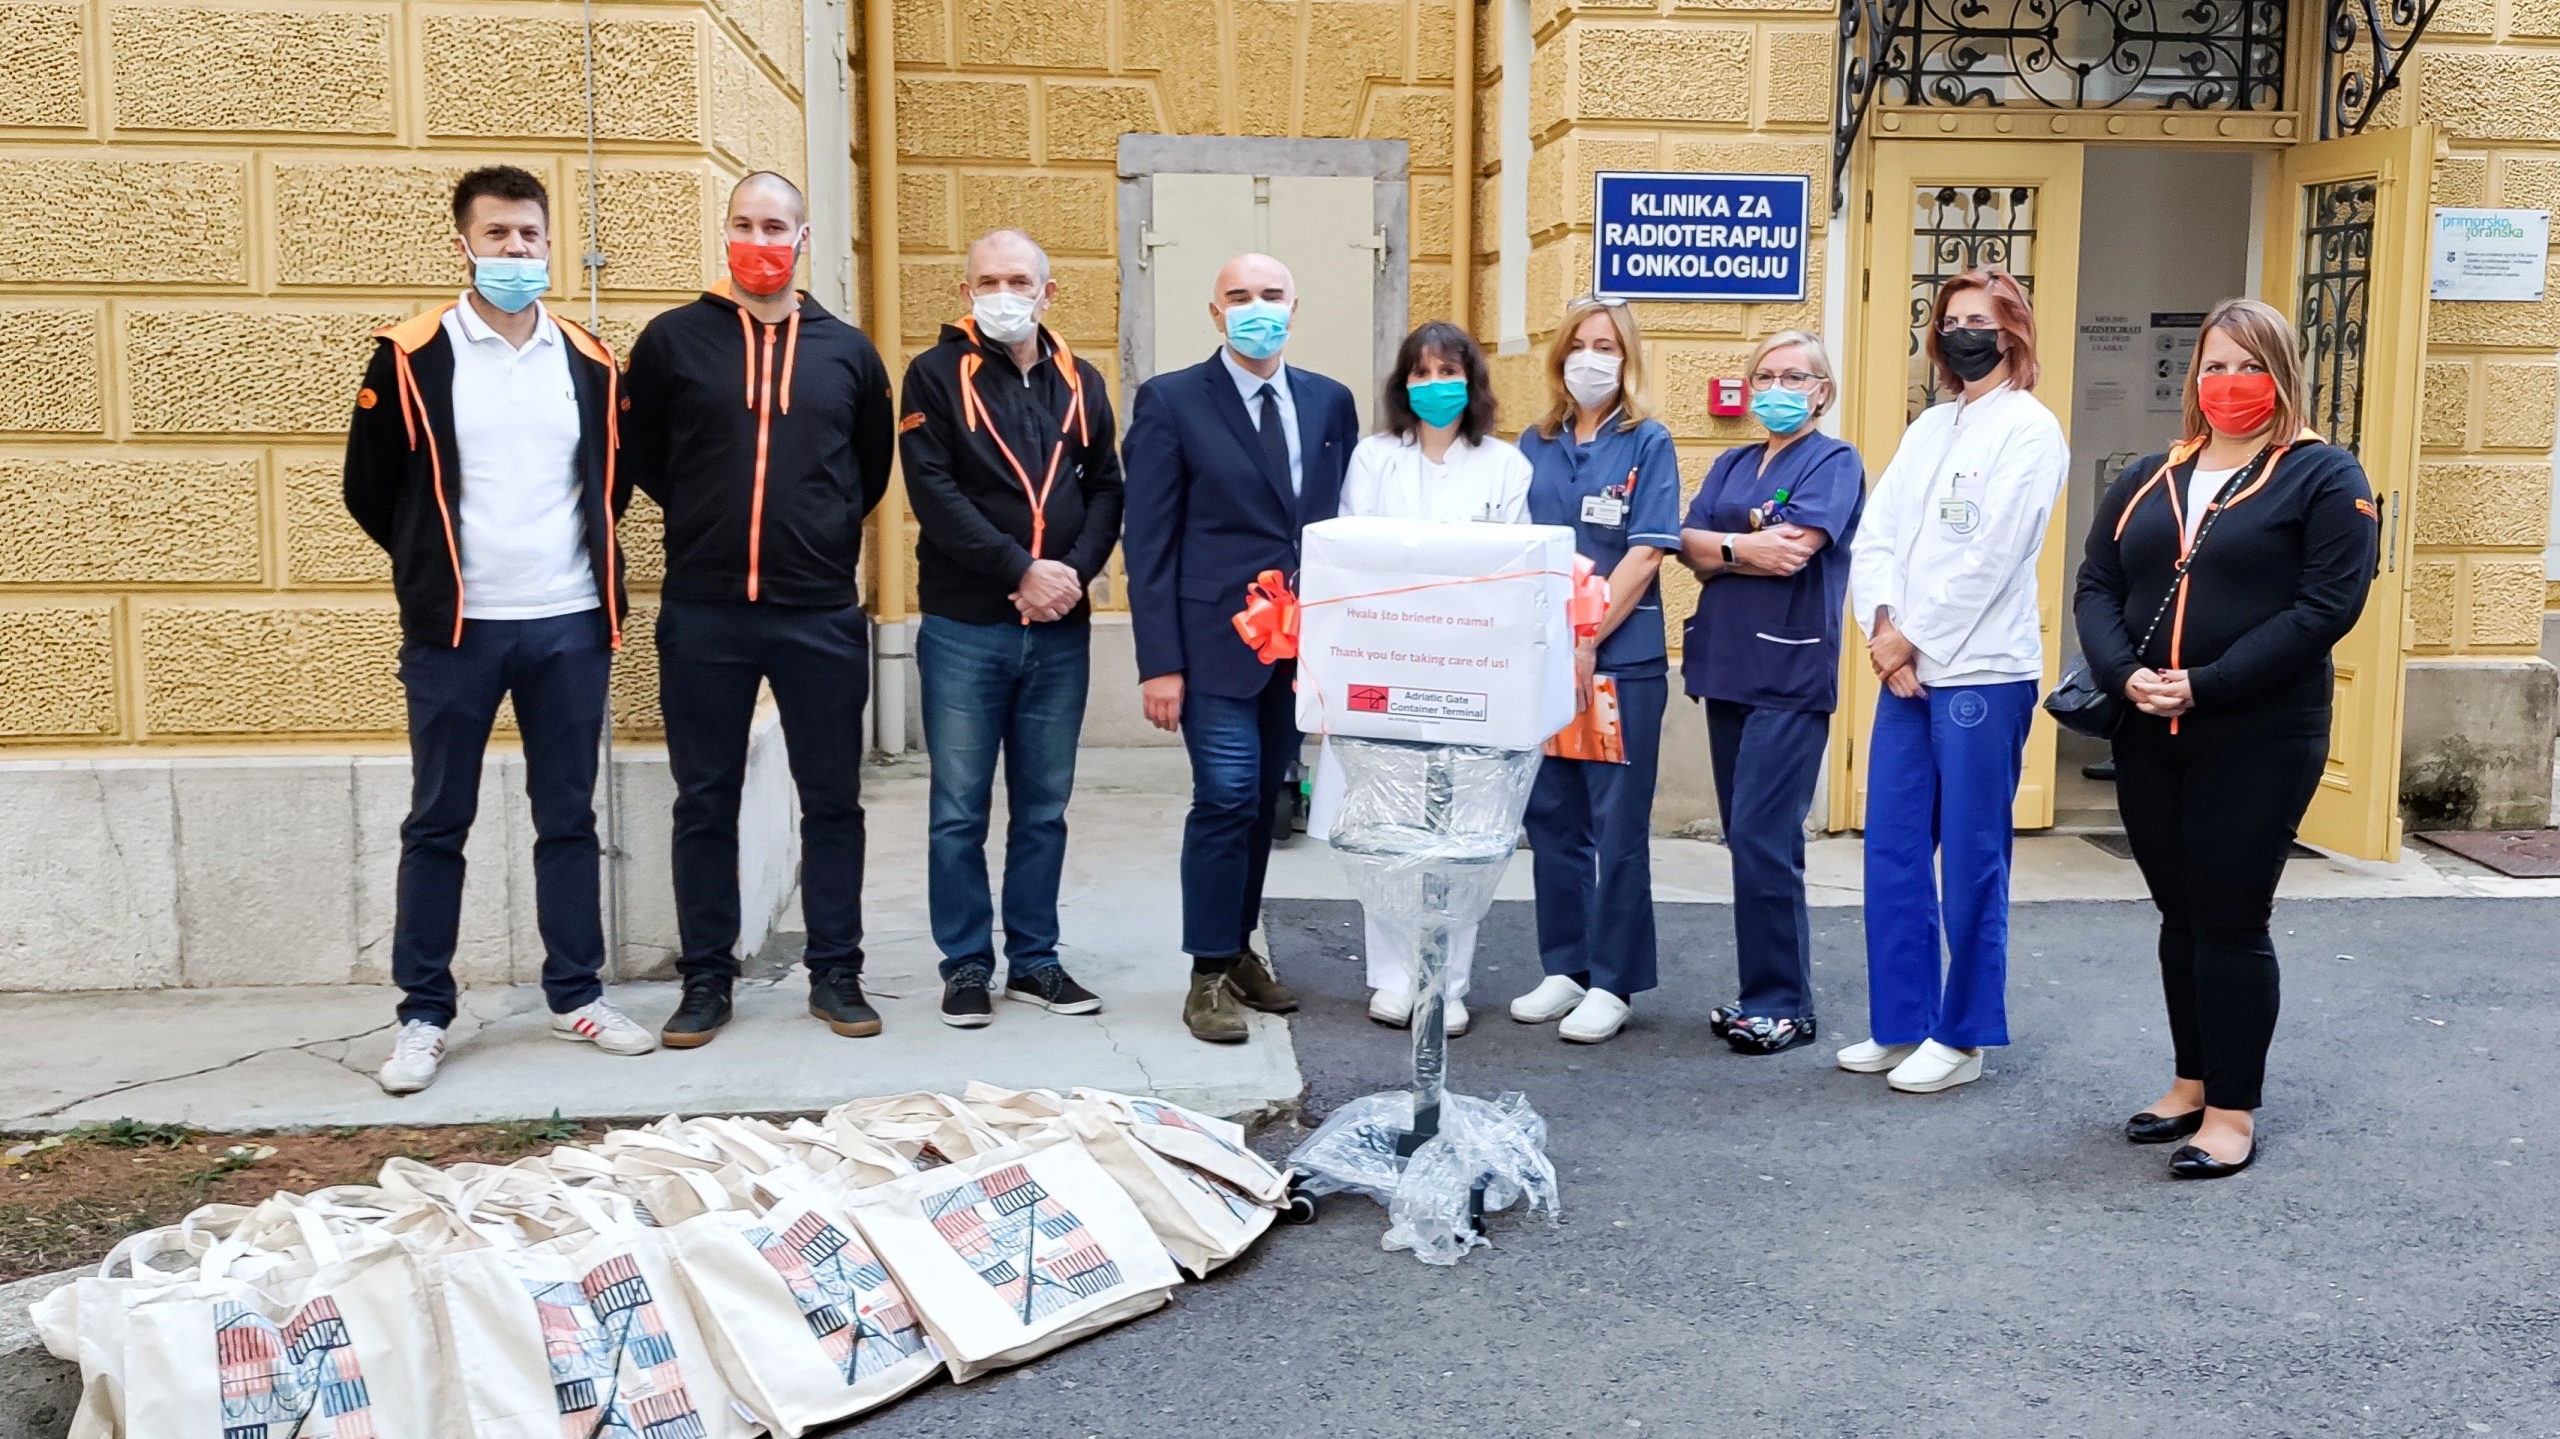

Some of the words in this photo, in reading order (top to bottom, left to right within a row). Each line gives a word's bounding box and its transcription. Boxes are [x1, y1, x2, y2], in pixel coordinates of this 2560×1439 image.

[1630, 194, 1730, 217] KLINIKA
[1738, 196, 1772, 218] ZA
[2442, 213, 2509, 230] primorsko
[1605, 224, 1797, 249] RADIOTERAPIJU
[2465, 224, 2524, 241] goranska
[1611, 254, 1620, 276] I
[1626, 254, 1789, 278] ONKOLOGIJU
[1347, 607, 1378, 620] Hvala
[1381, 609, 1399, 621] što
[1402, 611, 1443, 624] brinete
[1446, 616, 1454, 625] o
[1456, 617, 1494, 628] nama!
[1330, 646, 1364, 659] Thank
[1366, 650, 1387, 660] you
[1390, 650, 1407, 661] for
[1410, 652, 1445, 666] taking
[1448, 656, 1472, 667] care
[1476, 656, 1489, 668] of
[1491, 658, 1509, 669] us!
[1404, 691, 1442, 703] Adriatic
[1445, 694, 1469, 704] Gate
[1390, 702, 1438, 714] Container
[1441, 706, 1483, 718] Terminal
